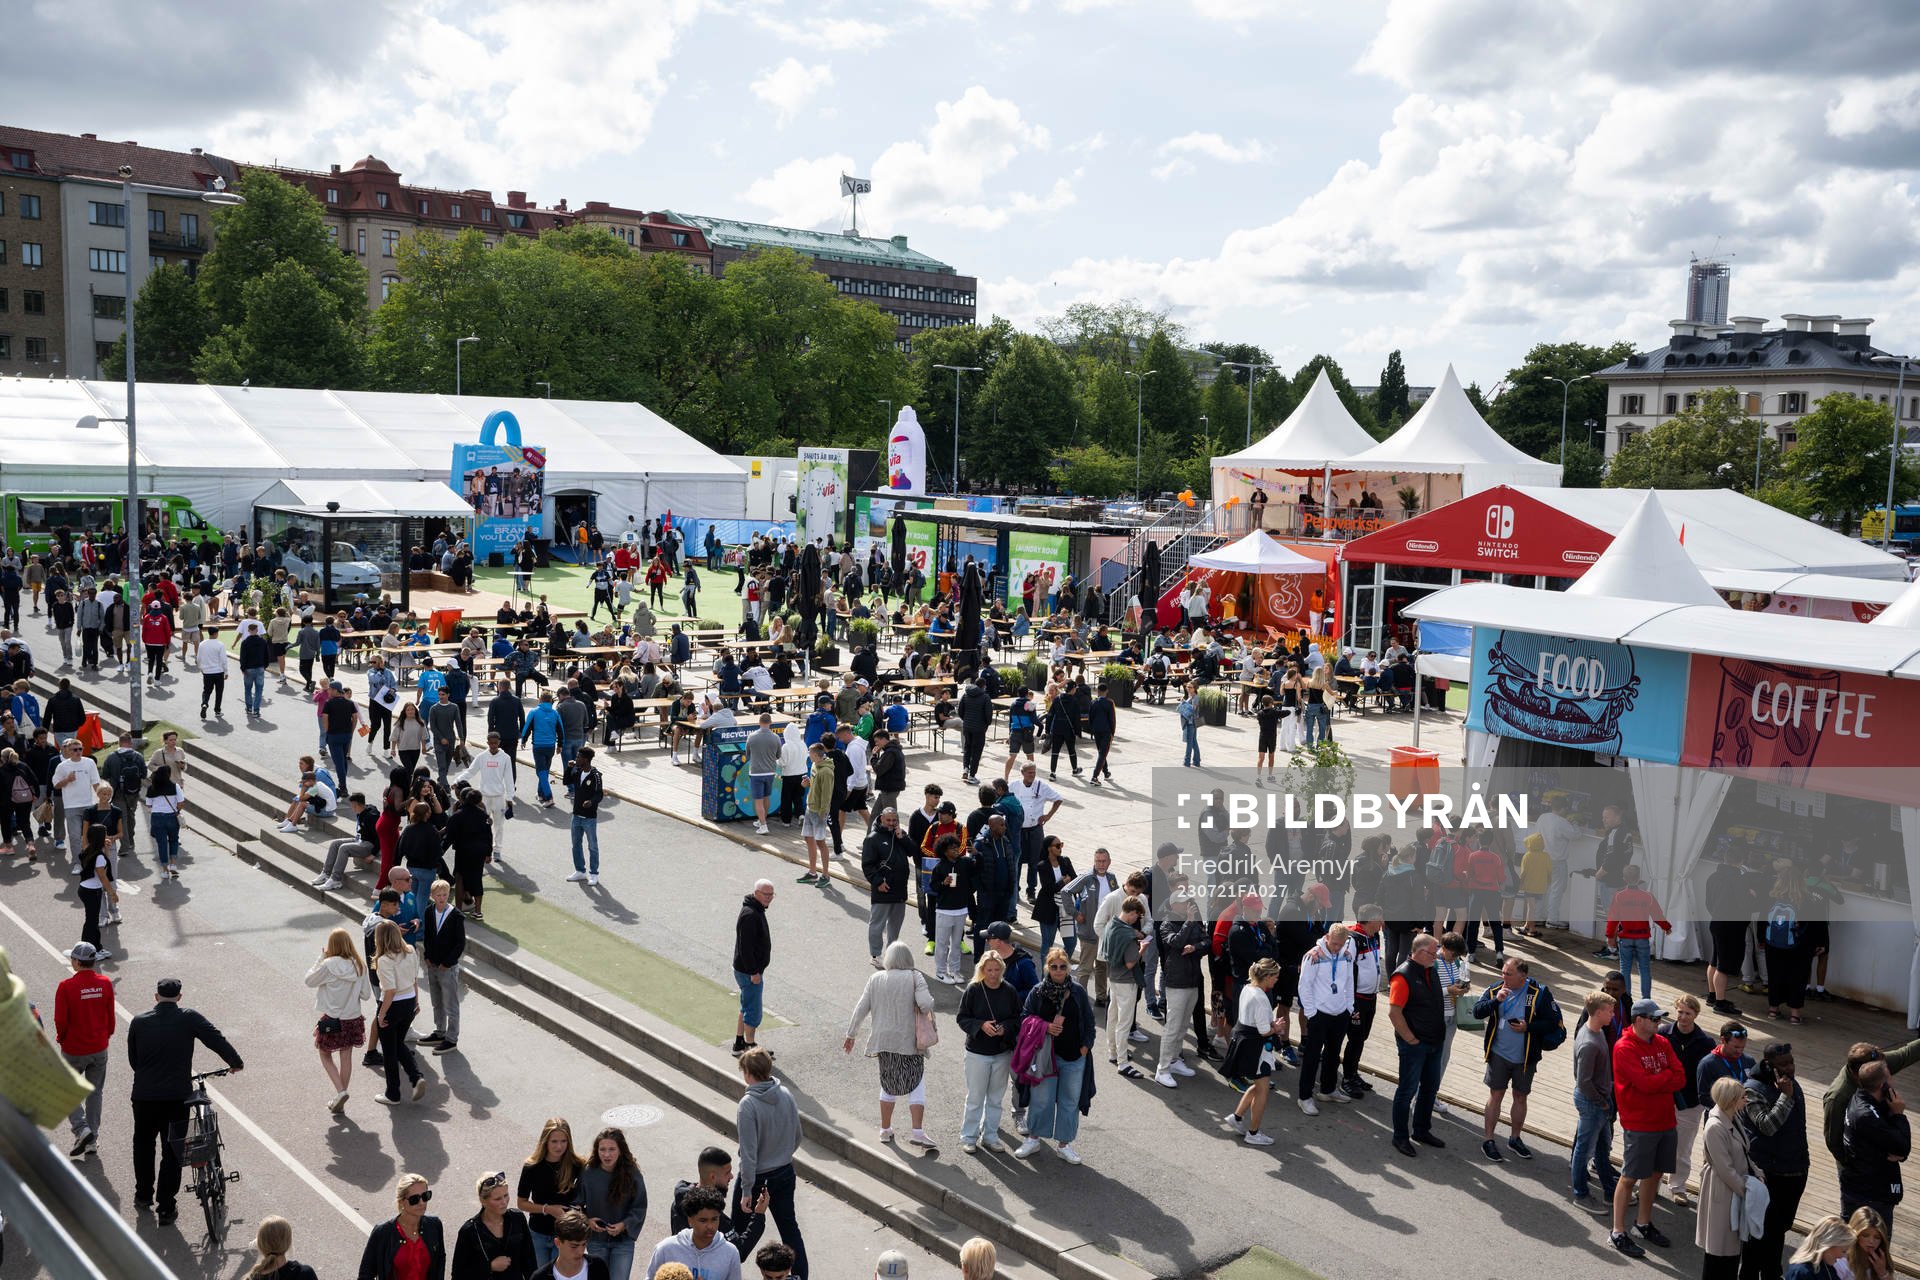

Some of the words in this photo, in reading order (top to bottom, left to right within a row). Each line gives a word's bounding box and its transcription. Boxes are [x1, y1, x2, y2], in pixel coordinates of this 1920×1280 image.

[847, 180, 869, 193] Vas
[889, 453, 901, 466] via
[822, 482, 835, 497] via
[499, 533, 525, 543] LOV
[1408, 542, 1437, 550] Nintendo
[1478, 541, 1519, 549] NINTENDO
[1477, 546, 1519, 559] SWITCH
[1565, 552, 1598, 561] Nintendo
[1536, 652, 1606, 699] FOOD
[427, 679, 441, 692] 70
[1751, 680, 1877, 739] COFFEE
[721, 730, 755, 739] RECYCLIN
